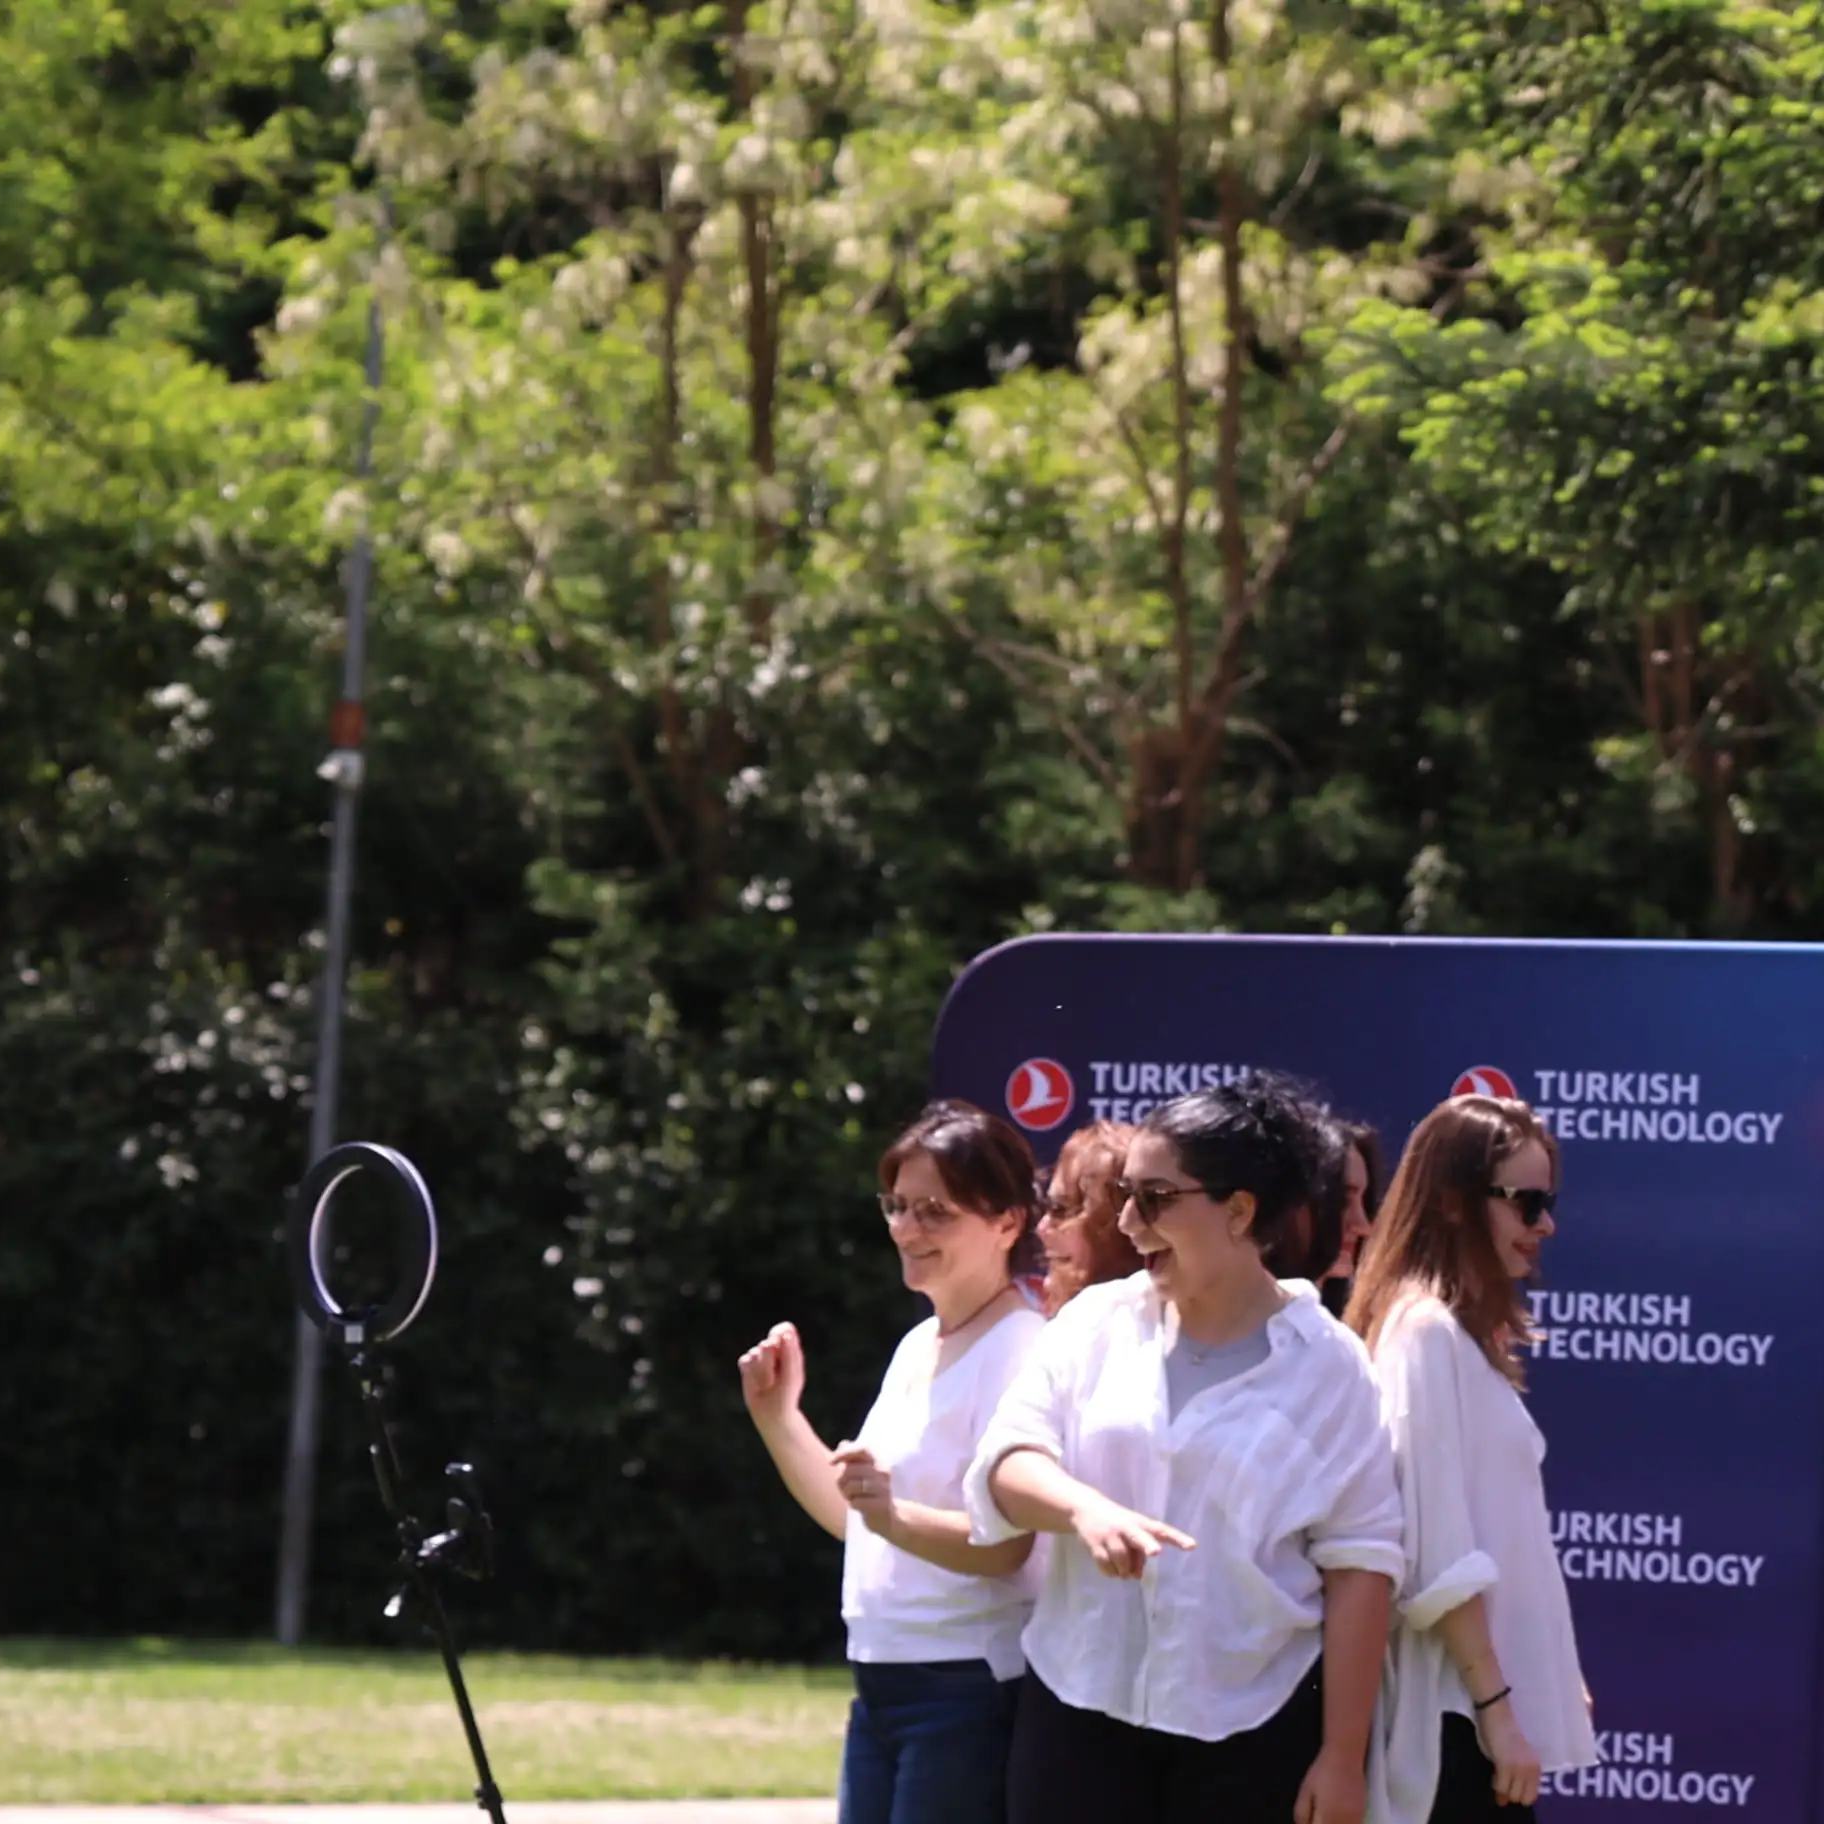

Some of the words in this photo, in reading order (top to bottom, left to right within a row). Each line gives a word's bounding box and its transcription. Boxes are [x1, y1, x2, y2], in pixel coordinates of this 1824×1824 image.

[1534, 1070, 1700, 1105] TURKISH
[1533, 1106, 1783, 1144] TECHNOLOGY
[1526, 1290, 1691, 1327] TURKISH
[1526, 1327, 1774, 1366] TECHNOLOGY
[1550, 1511, 1681, 1546] URKISH
[1562, 1547, 1764, 1586] CHNOLOGY
[1594, 1731, 1673, 1764] KISH
